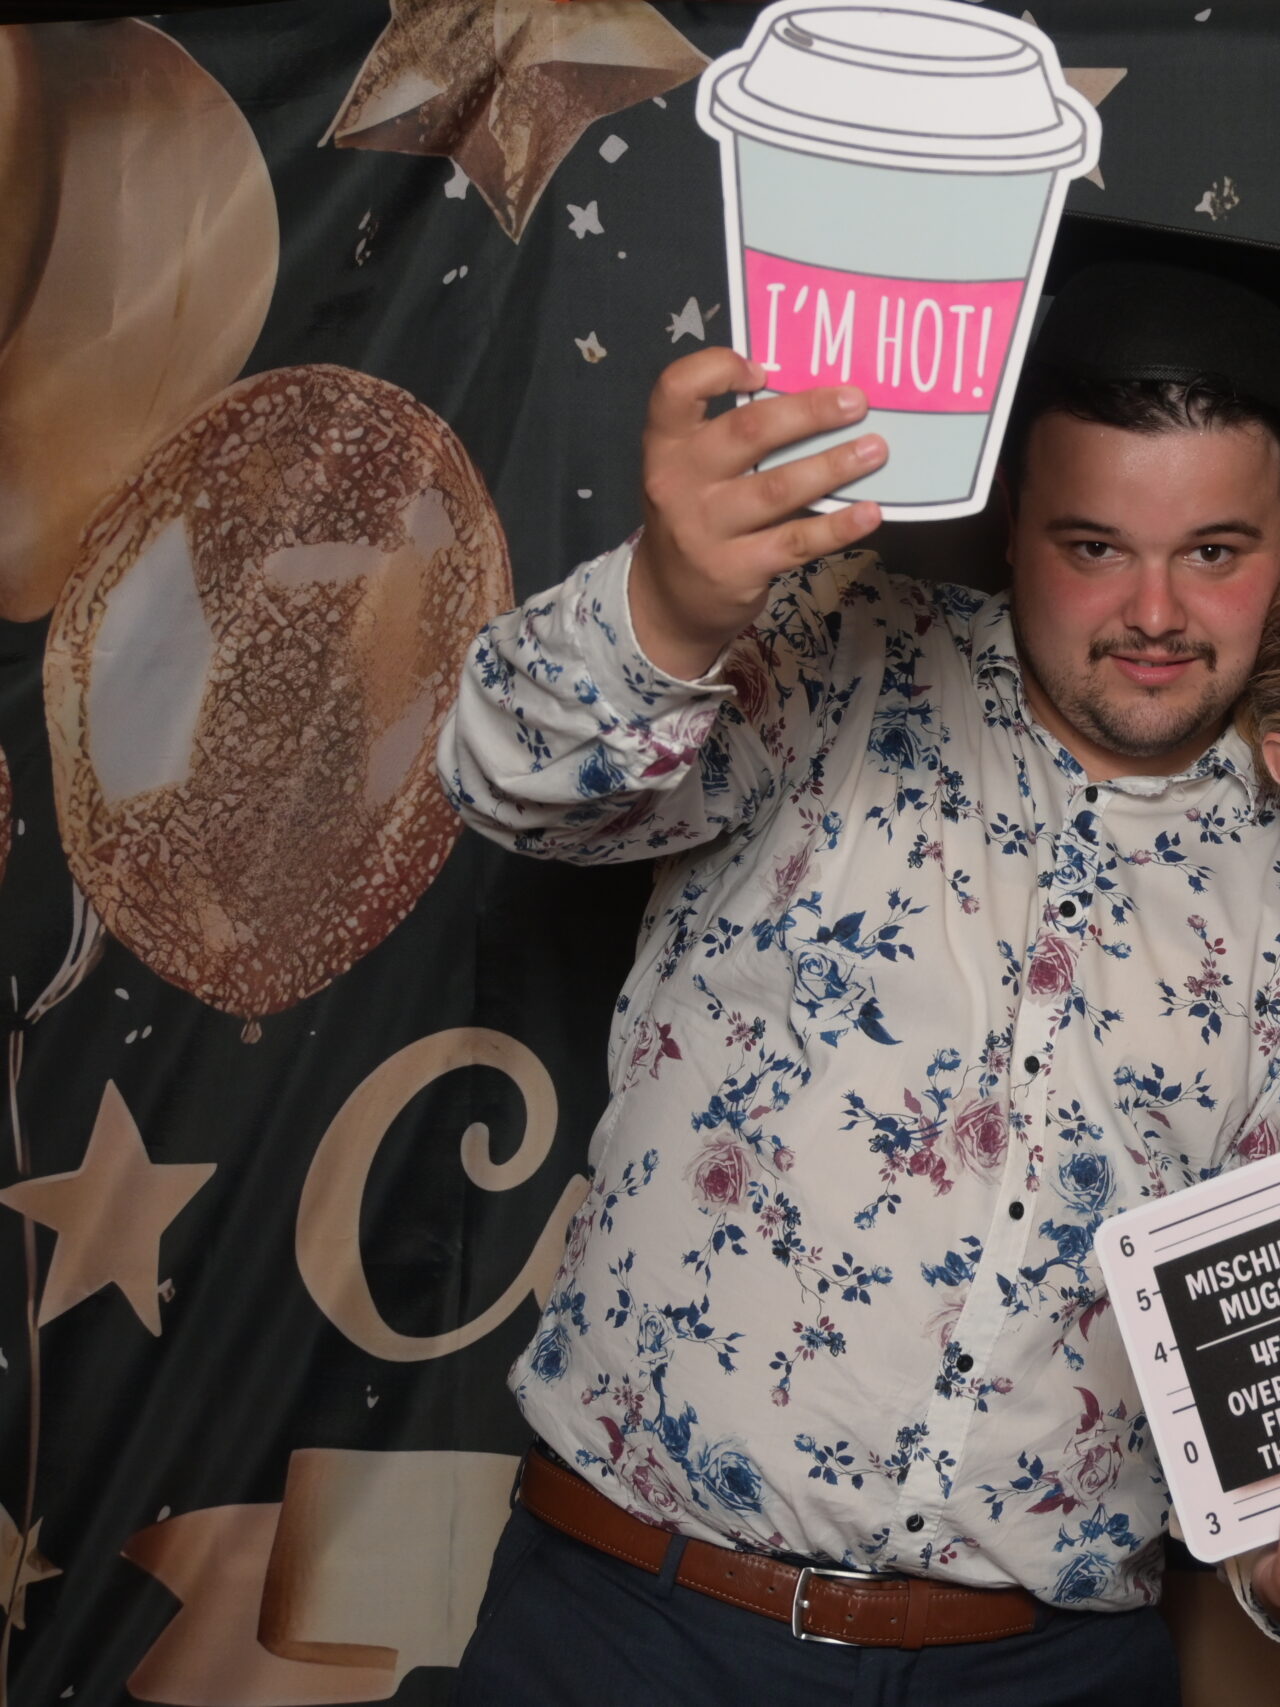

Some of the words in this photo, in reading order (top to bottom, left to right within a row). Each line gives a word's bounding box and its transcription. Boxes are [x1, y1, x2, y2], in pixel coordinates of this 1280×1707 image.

[759, 282, 856, 383] I'M
[876, 295, 993, 399] HOT!
[1119, 1235, 1135, 1258] 6
[1136, 1288, 1152, 1312] 5
[1153, 1341, 1168, 1364] 4
[1205, 1512, 1222, 1535] 3
